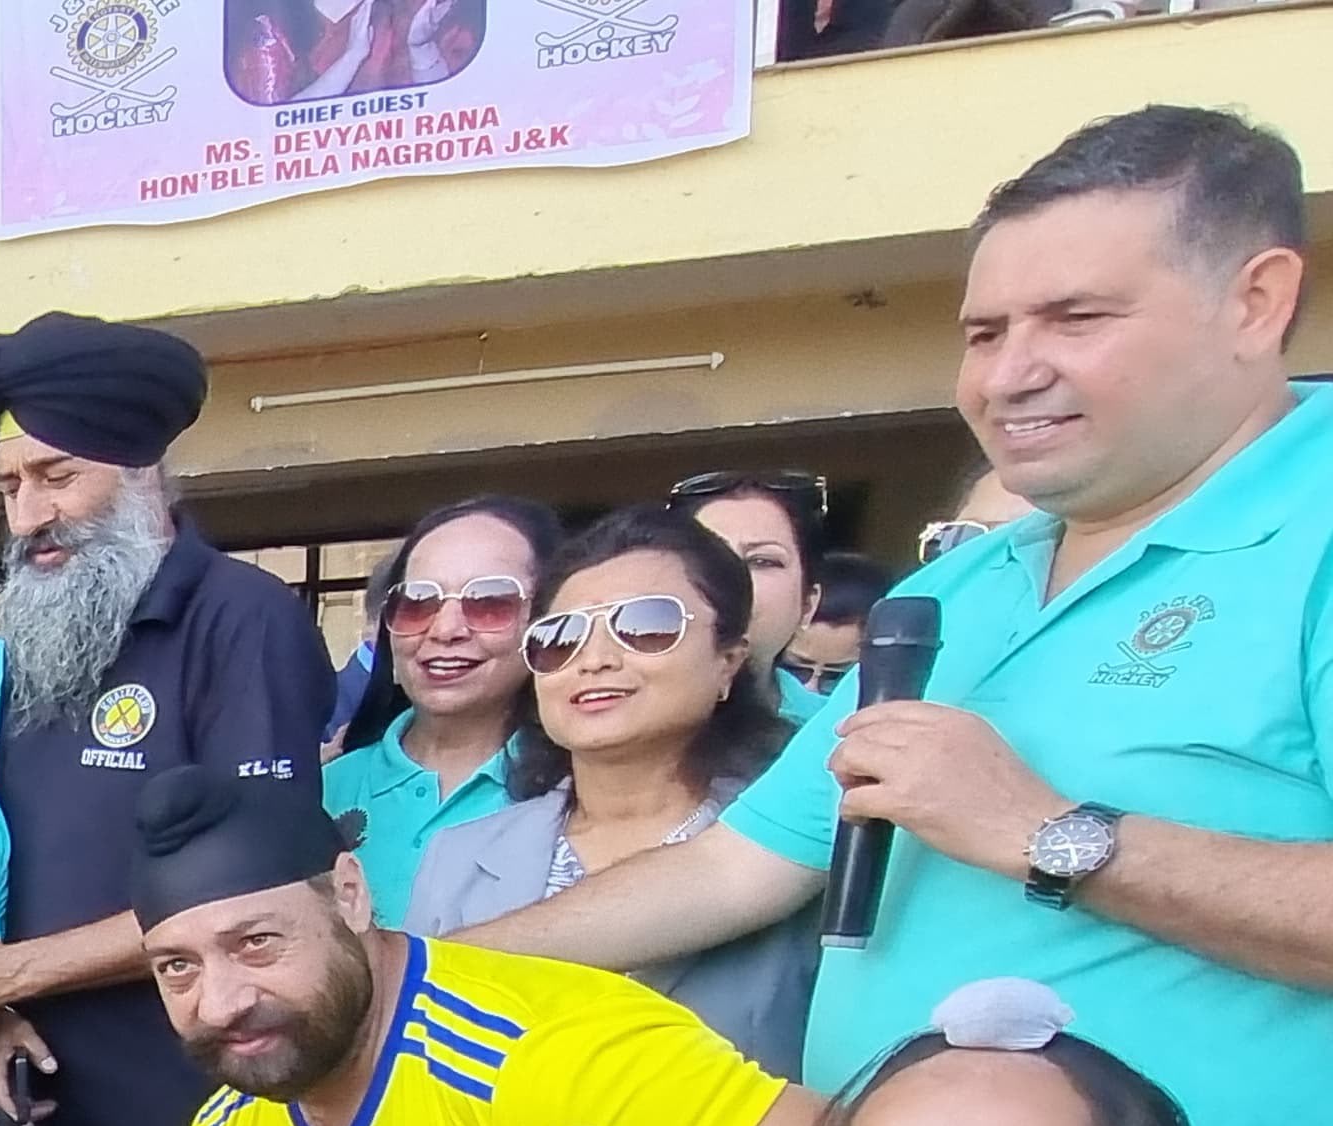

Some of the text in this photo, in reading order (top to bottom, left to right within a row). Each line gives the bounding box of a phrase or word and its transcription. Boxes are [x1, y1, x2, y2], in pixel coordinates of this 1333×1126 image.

[537, 30, 676, 69] HOCKEY
[52, 101, 174, 137] HOCKEY
[275, 92, 429, 128] CHIEF GUEST
[205, 106, 500, 165] MS. DEVYANI RANA
[140, 124, 571, 201] HON'BLE MLA NAGROTA J&K
[81, 748, 146, 770] OFFICIAL
